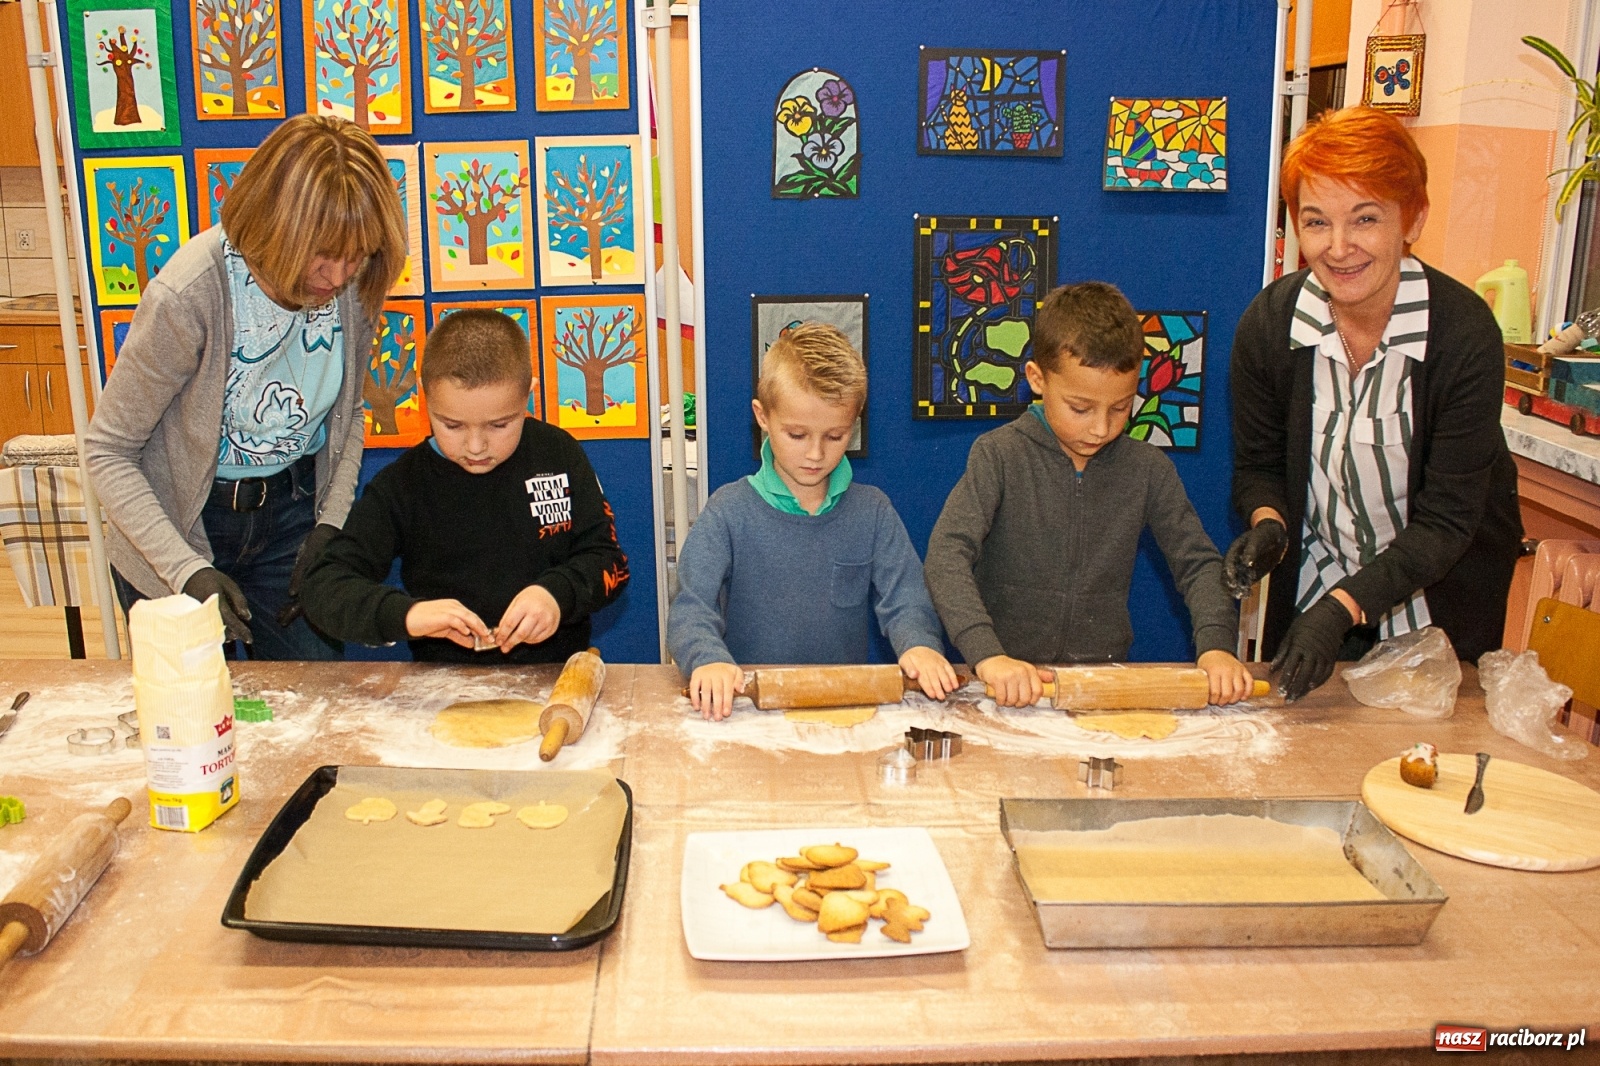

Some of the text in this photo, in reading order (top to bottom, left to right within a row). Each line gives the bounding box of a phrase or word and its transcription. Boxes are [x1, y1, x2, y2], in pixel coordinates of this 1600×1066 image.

[531, 477, 565, 502] NEW
[534, 500, 572, 526] YORK
[199, 747, 236, 775] TORTO
